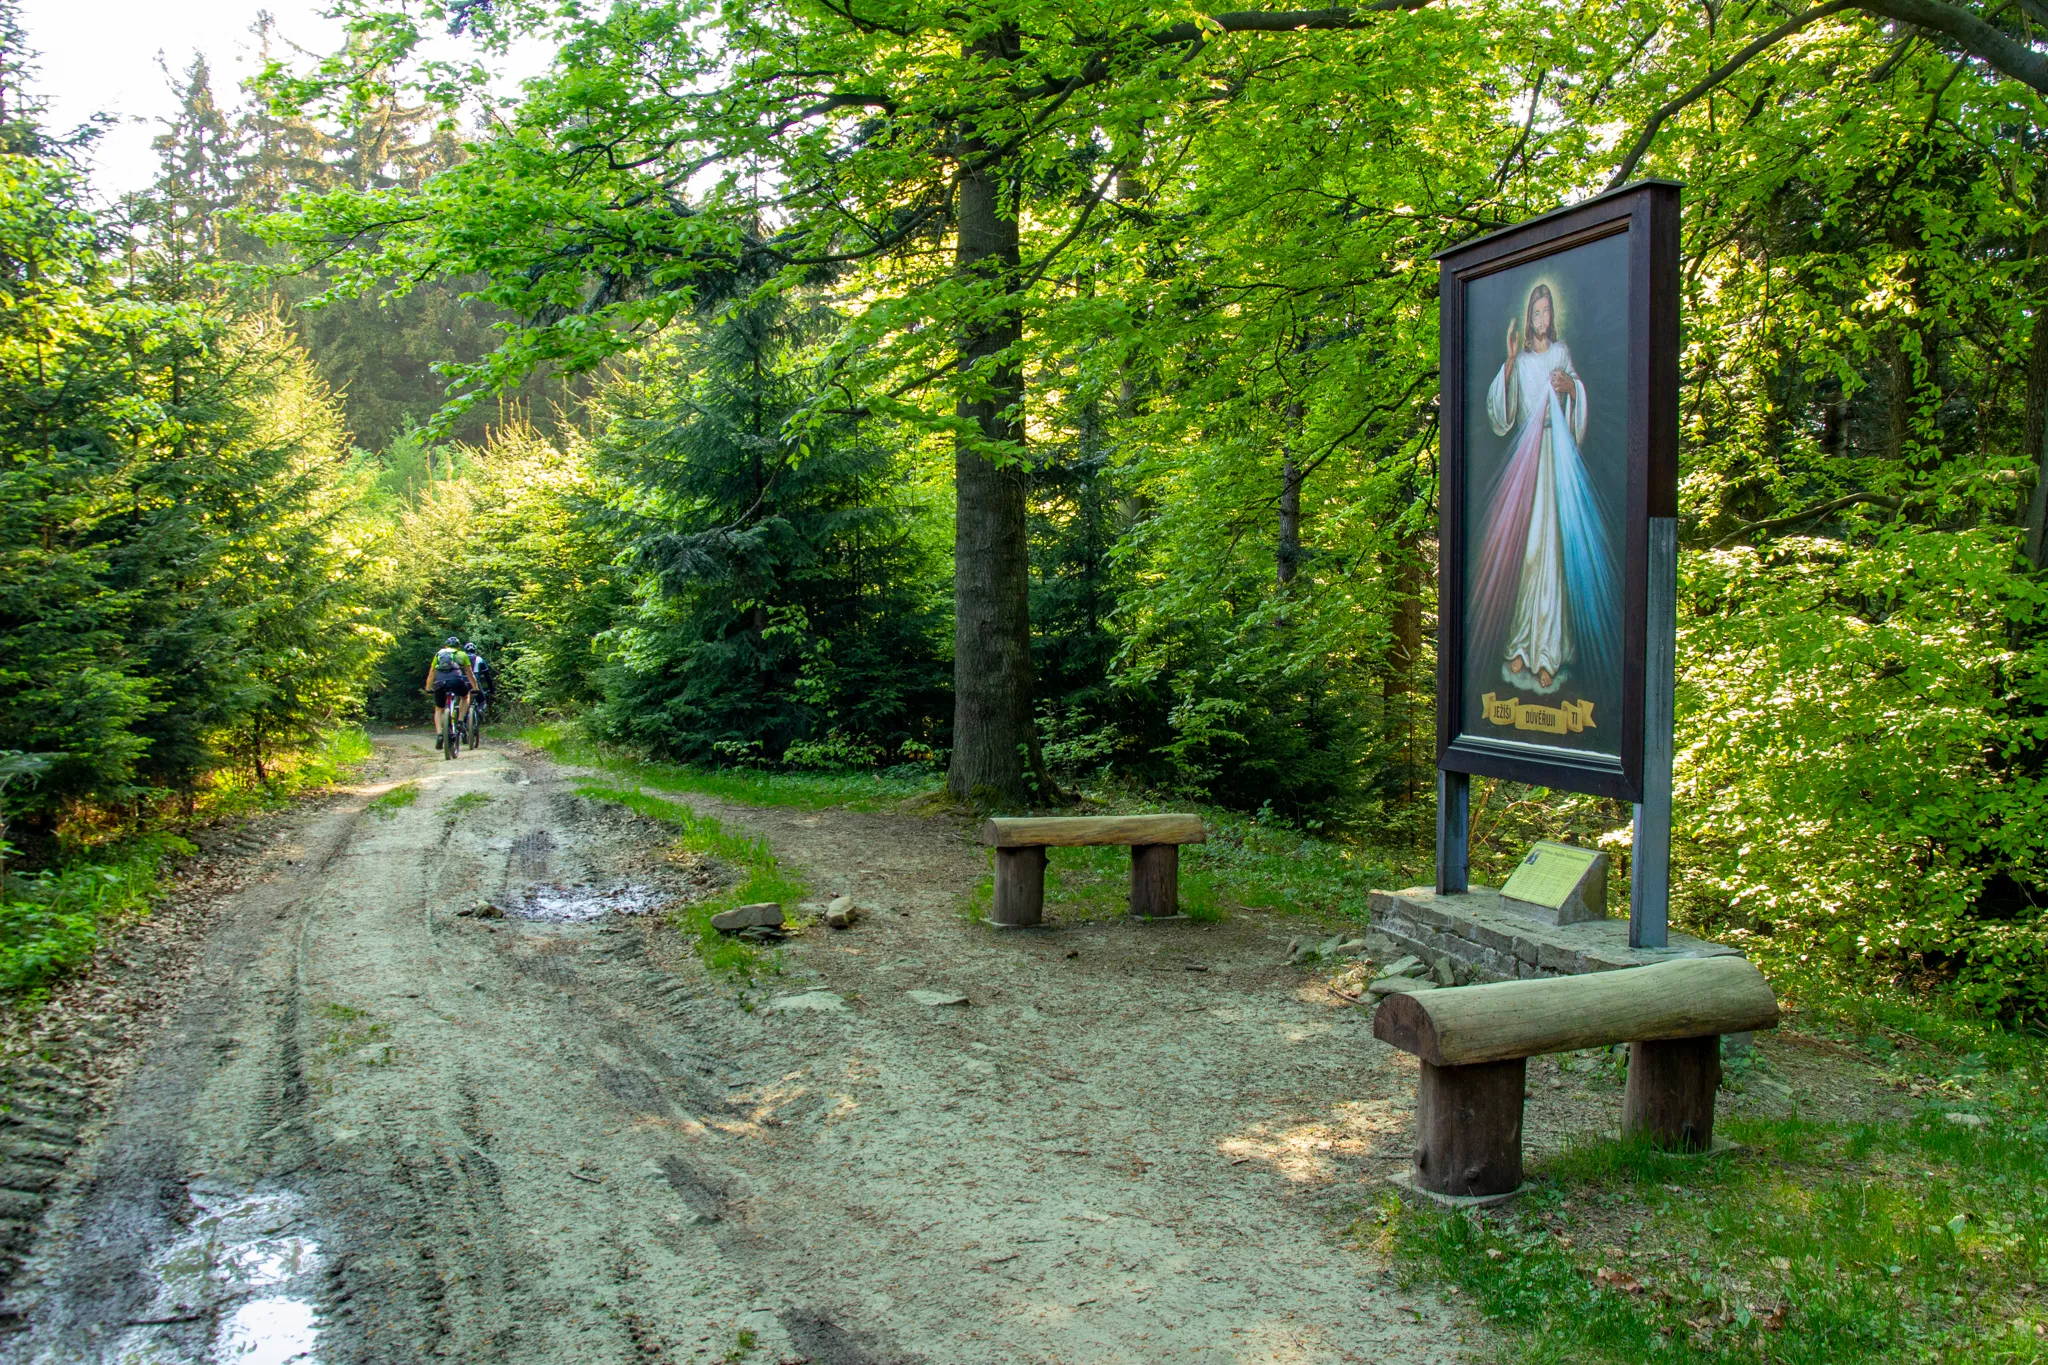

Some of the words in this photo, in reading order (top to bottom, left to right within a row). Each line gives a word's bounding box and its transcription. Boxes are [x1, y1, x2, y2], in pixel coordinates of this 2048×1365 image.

[1494, 704, 1512, 719] JEŽÍŠI
[1526, 708, 1556, 727] DŮVĚŘUJI
[1571, 712, 1578, 725] TI
